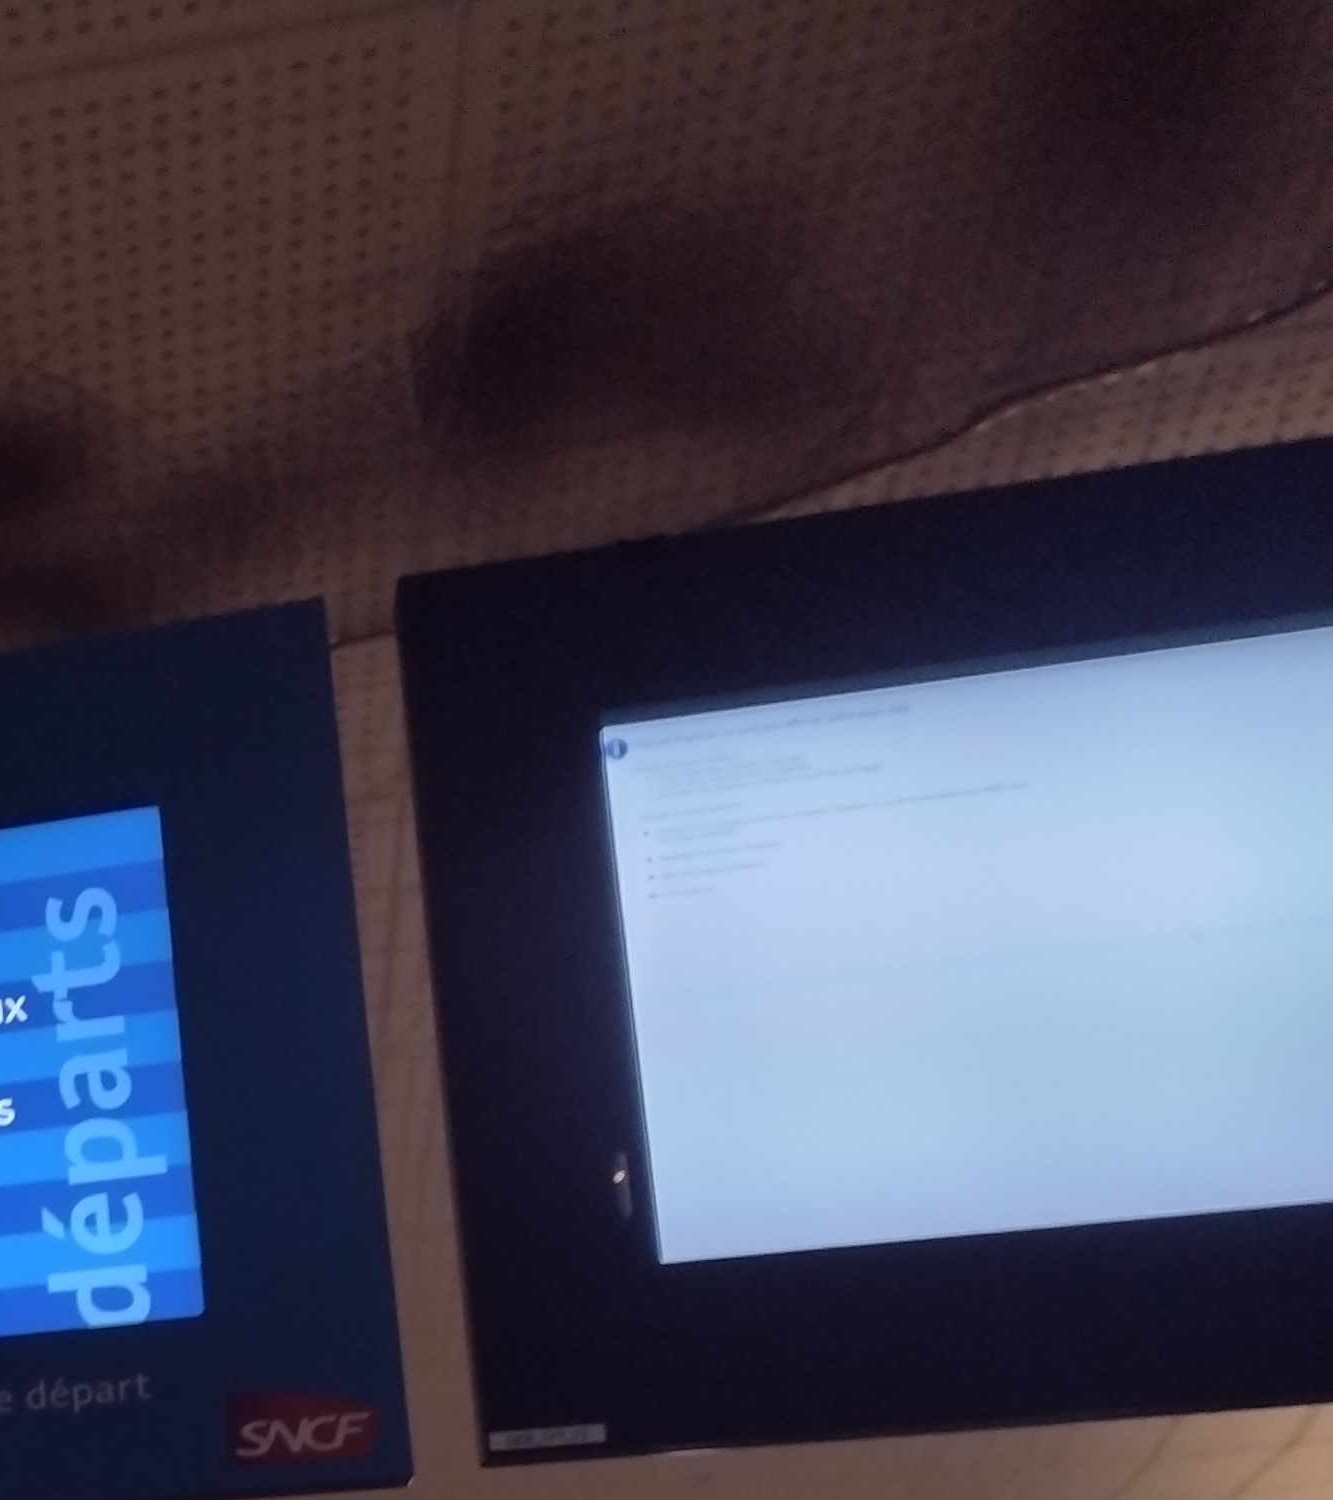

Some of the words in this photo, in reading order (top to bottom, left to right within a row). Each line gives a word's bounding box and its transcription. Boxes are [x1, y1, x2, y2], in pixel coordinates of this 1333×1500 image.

[31, 887, 168, 1329] départs
[26, 1372, 150, 1417] départ
[235, 1413, 371, 1457] SNCF
